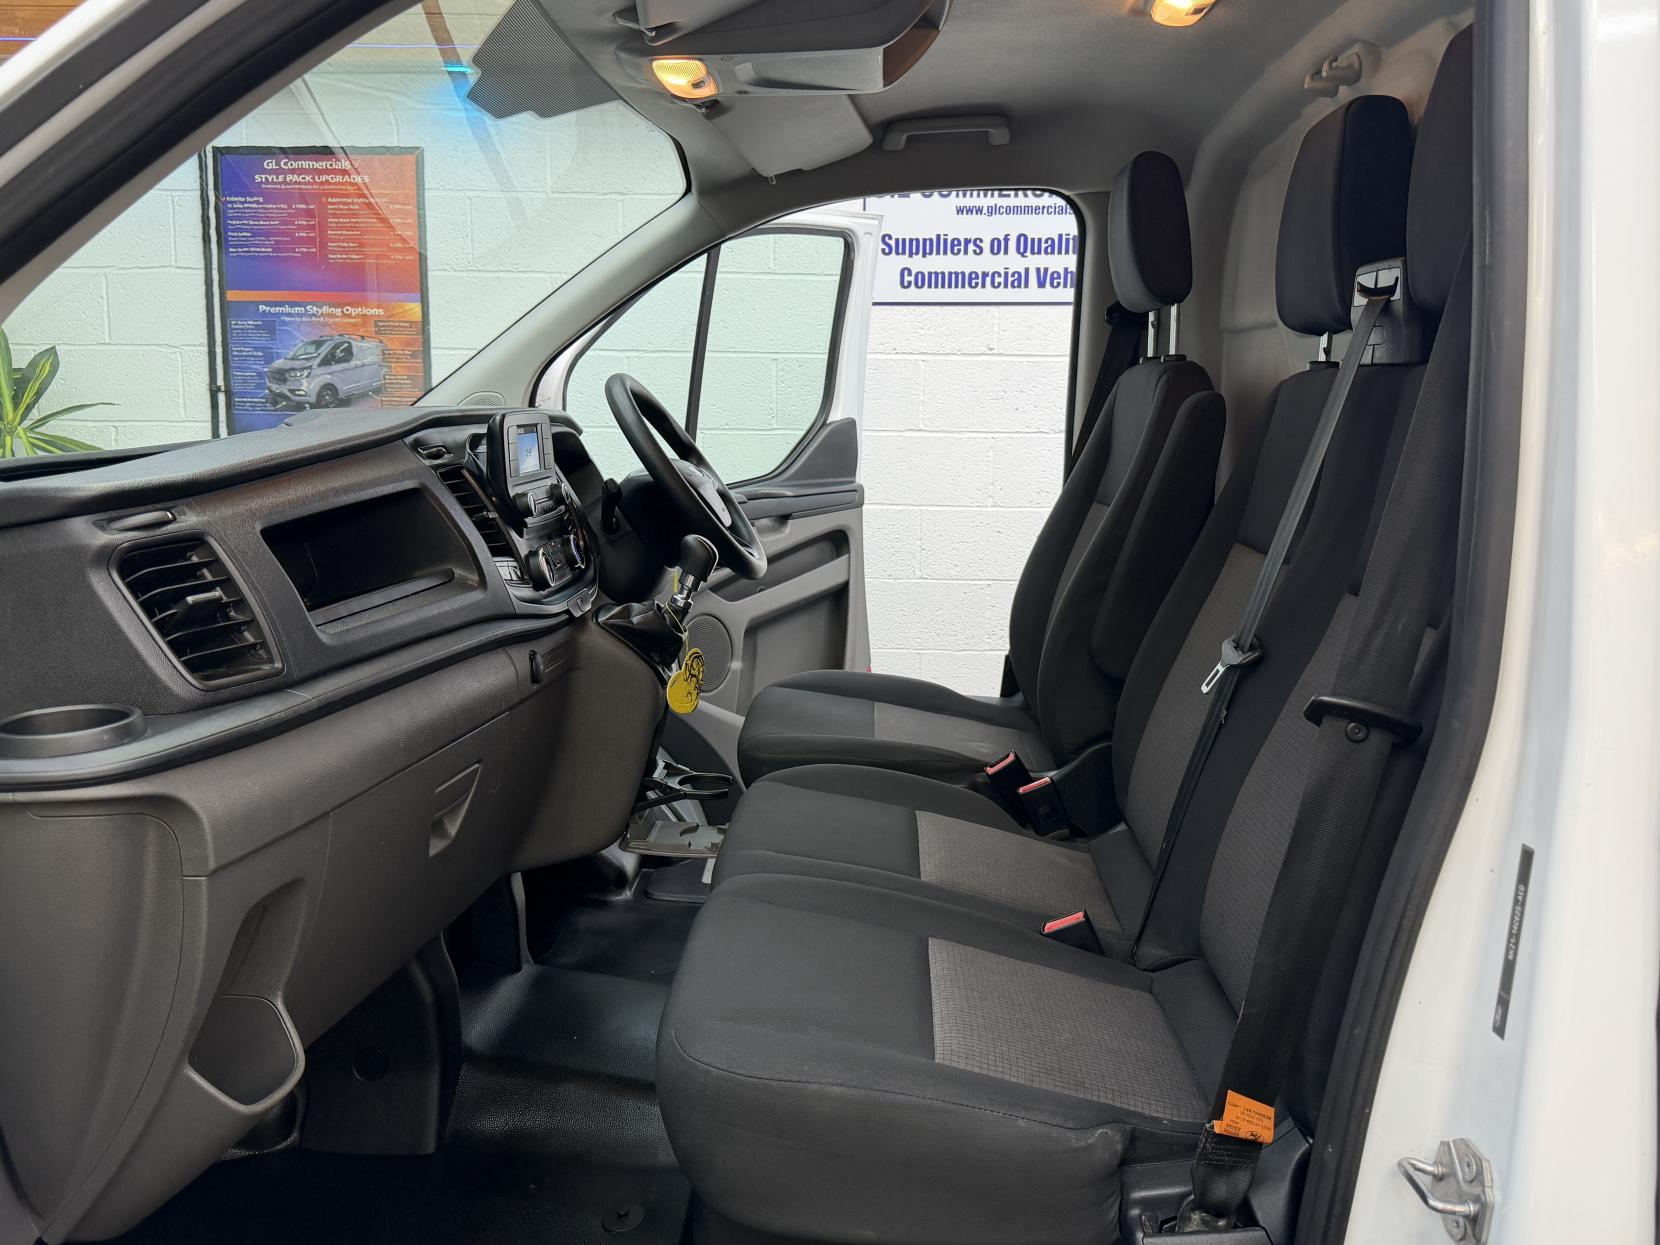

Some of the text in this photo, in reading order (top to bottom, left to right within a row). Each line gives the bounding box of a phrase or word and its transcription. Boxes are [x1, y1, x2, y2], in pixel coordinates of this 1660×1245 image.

[264, 158, 352, 171] GL Commercials
[254, 174, 370, 185] STYLE PACK UPGRADES
[880, 233, 984, 258] Suppliers
[989, 233, 1011, 256] of
[898, 266, 1030, 289] Commercial
[259, 304, 385, 317] Premium Styling Options
